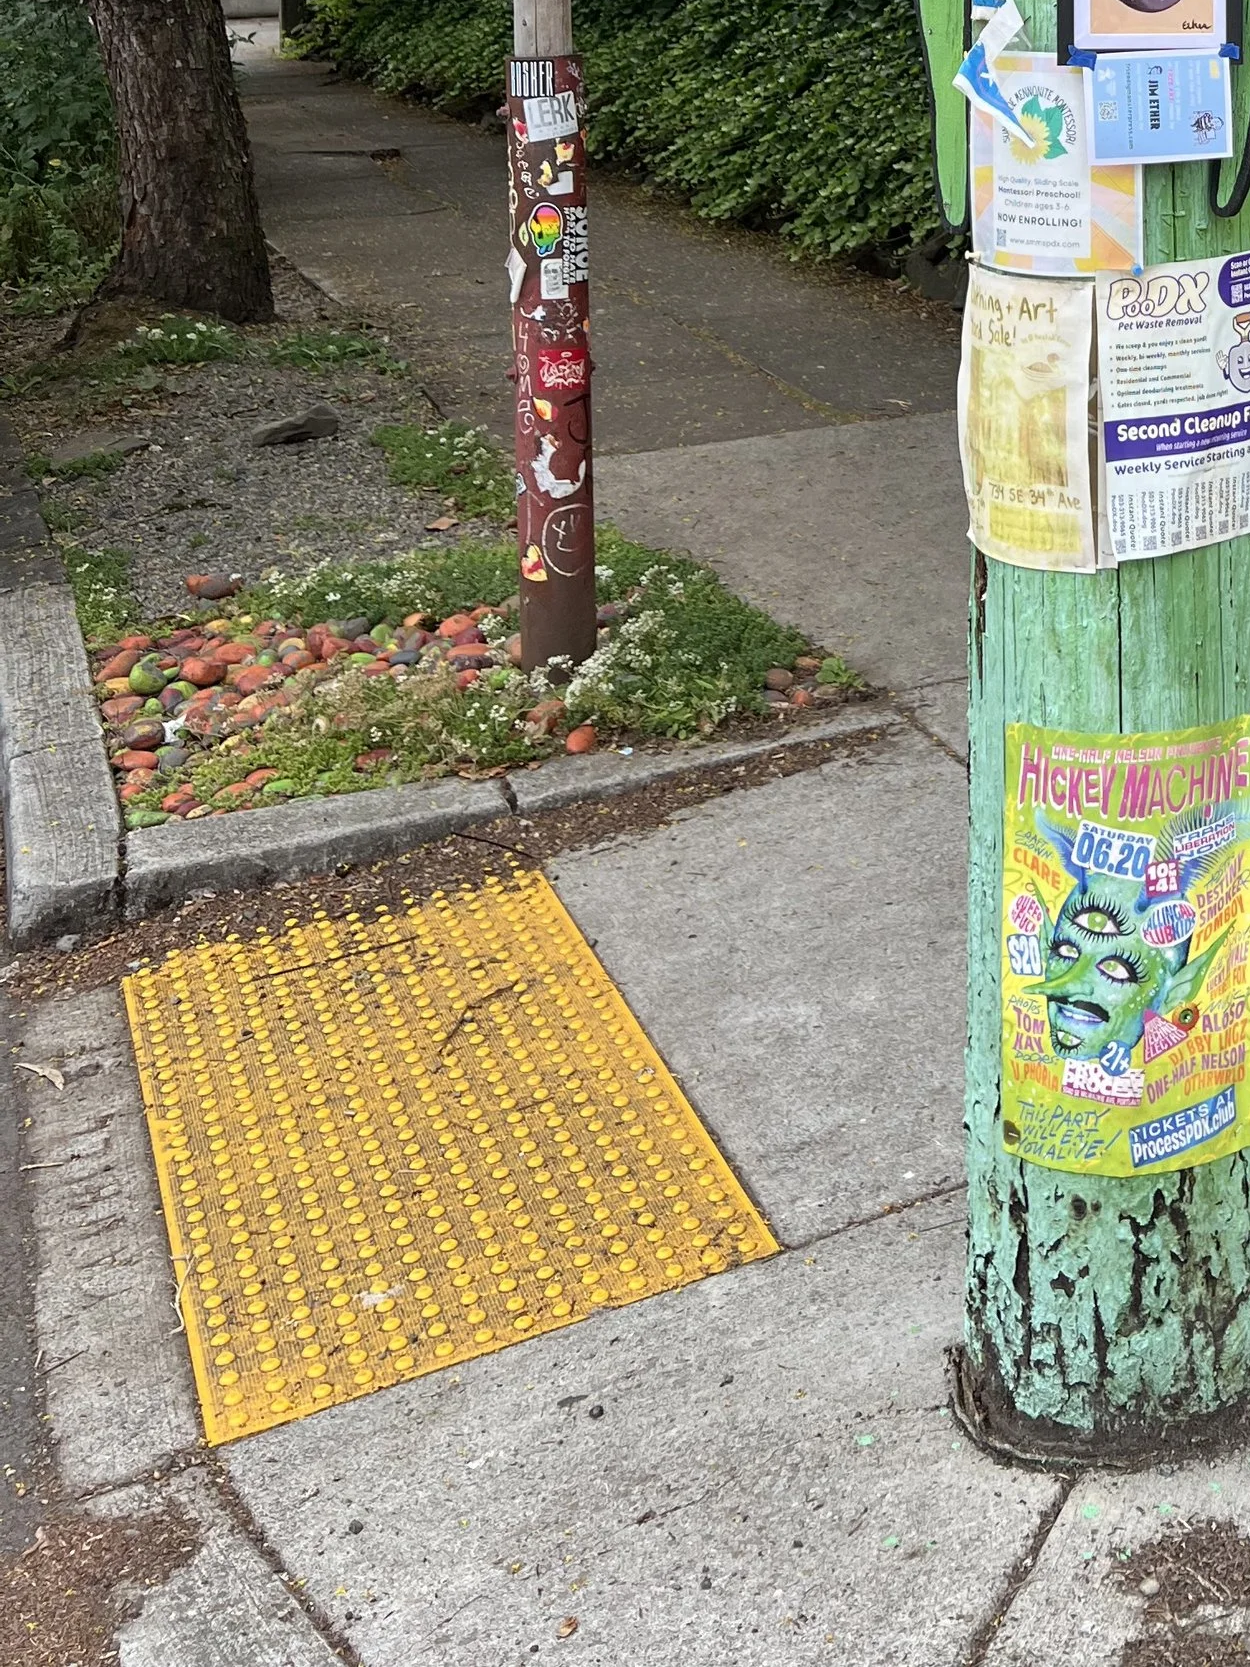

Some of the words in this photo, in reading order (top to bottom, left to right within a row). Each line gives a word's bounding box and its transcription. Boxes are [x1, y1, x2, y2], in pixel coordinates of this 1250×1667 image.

[1148, 80, 1159, 96] JIM
[528, 94, 574, 128] LERK
[1052, 95, 1076, 146] MONTESSORI
[1149, 99, 1160, 130] ETHER
[998, 186, 1034, 196] Montessori
[1004, 198, 1032, 207] Children
[1034, 202, 1054, 212] ages
[1056, 202, 1070, 211] 3-6
[998, 212, 1017, 223] NOW
[1018, 215, 1082, 228] ENROLLING!
[569, 236, 576, 252] TO
[562, 248, 570, 284] FORGET
[1006, 301, 1012, 314] +
[1019, 296, 1058, 324] Art
[1118, 320, 1134, 332] Pet
[1136, 320, 1164, 330] Waste
[1166, 315, 1202, 328] Removal
[989, 318, 1016, 347] Sale!
[1148, 341, 1158, 350] you
[1159, 340, 1174, 349] enjoy
[1168, 350, 1190, 359] monthly
[1116, 376, 1148, 385] Residential
[1116, 418, 1180, 442] Second
[1184, 410, 1241, 434] Cleanup
[1174, 440, 1196, 450] starting
[1114, 460, 1161, 476] Weekly
[1164, 456, 1206, 471] Service
[1206, 446, 1246, 463] Starting
[1009, 488, 1024, 502] SE
[1058, 492, 1082, 510] Ave
[1114, 744, 1162, 765] NELSON
[1018, 741, 1117, 820] HICKEY
[1117, 736, 1250, 822] MACHINE
[1082, 823, 1154, 845] SATURDAY
[1175, 814, 1234, 842] TRANS
[1175, 822, 1235, 854] LIBERATION
[1076, 832, 1150, 878] 06.20
[1176, 830, 1234, 861] NOW!
[1013, 846, 1061, 891] CLARE
[1196, 849, 1246, 910] DESTINY
[1196, 894, 1244, 952] TOMBOY
[1008, 934, 1042, 975] $20
[1013, 1005, 1046, 1034] TOM
[1202, 1000, 1246, 1033] ALOSO
[1012, 1032, 1044, 1054] KAY
[1101, 1041, 1130, 1071] 21+
[1168, 1047, 1184, 1066] DJ
[1186, 1034, 1212, 1056] BBY
[1146, 1056, 1196, 1104] ONE-HALF
[1202, 1042, 1246, 1071] NELSON
[1184, 1064, 1245, 1096] OTHRWRLD
[1018, 1100, 1048, 1124] THIS
[1052, 1104, 1112, 1131] PARTY
[1130, 1104, 1209, 1142] TICKETS
[1216, 1088, 1232, 1109] AT
[1016, 1138, 1042, 1154] YOU
[1044, 1129, 1122, 1161] ALIVE!
[1024, 1126, 1057, 1140] WILL
[1060, 1129, 1098, 1146] EAT
